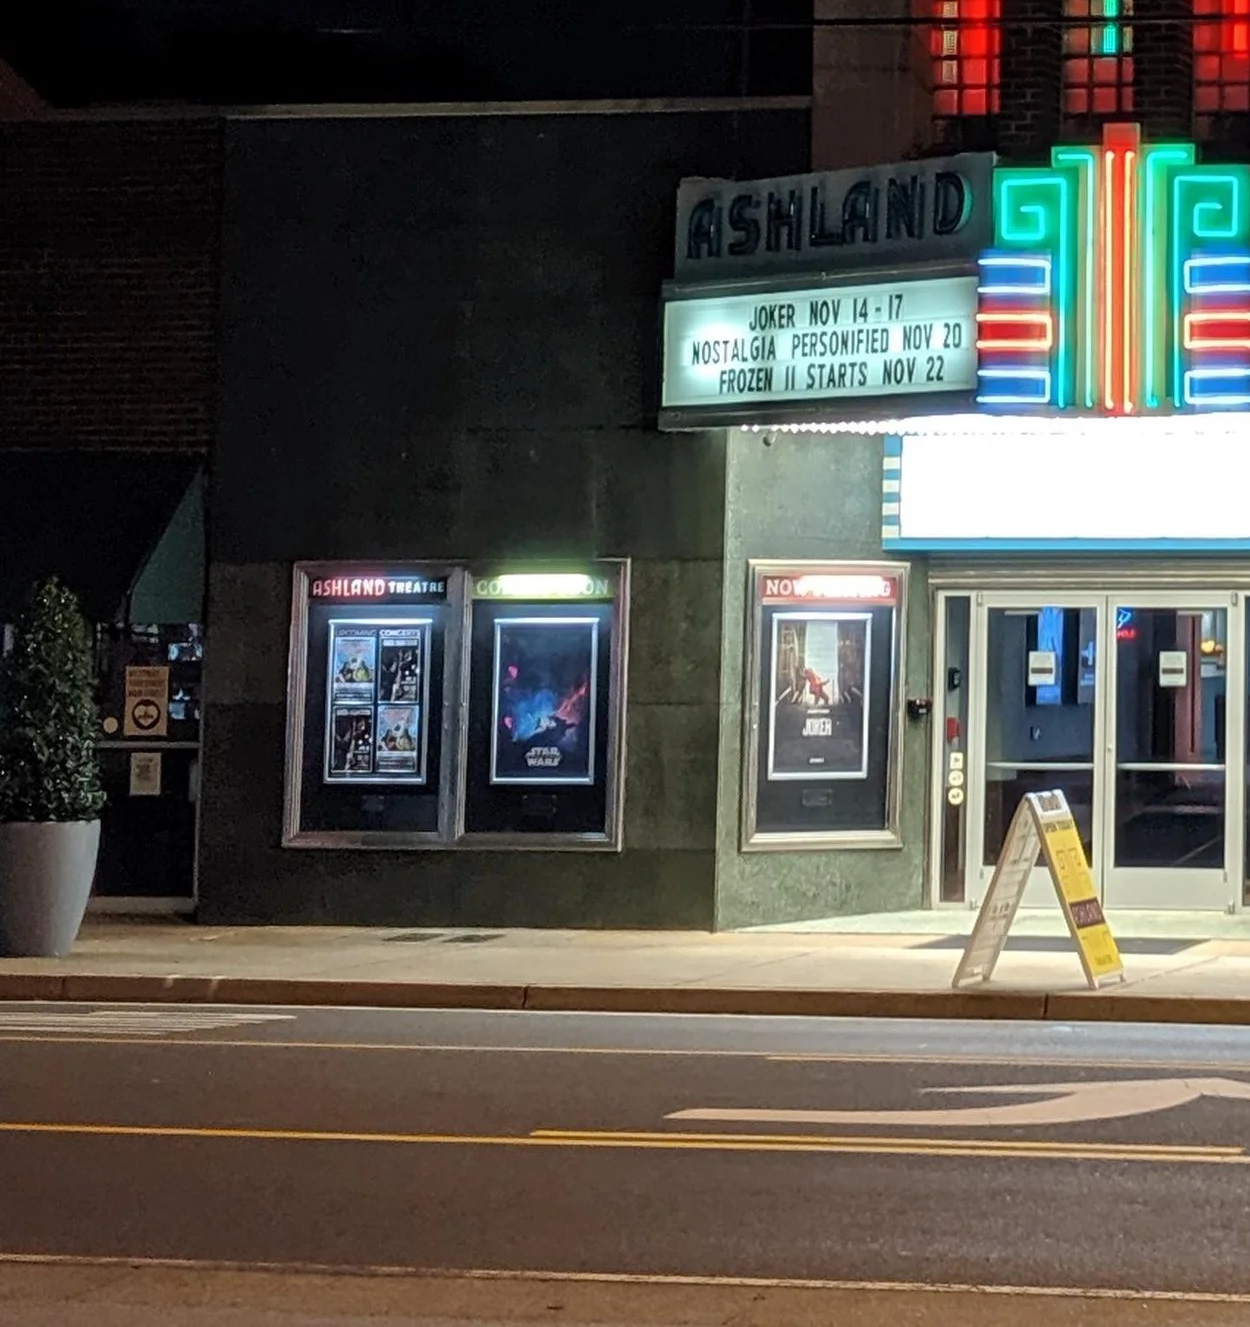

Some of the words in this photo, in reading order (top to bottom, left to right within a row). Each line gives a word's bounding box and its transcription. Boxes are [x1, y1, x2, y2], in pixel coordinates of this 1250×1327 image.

[686, 171, 970, 260] ASHLAND
[749, 304, 796, 332] JOKER
[808, 299, 841, 325] NOV
[852, 297, 869, 323] 14
[887, 294, 904, 320] 17
[692, 335, 778, 366] NOSTALGIA
[791, 326, 890, 359] PERSONIFIED
[902, 324, 934, 351] NOV
[943, 322, 962, 349] 20
[719, 368, 774, 394] FROZEN
[806, 362, 868, 390] STARTS
[882, 358, 916, 385] NOV
[925, 355, 945, 382] 22
[312, 577, 386, 597] ASHLAND
[388, 580, 445, 594] THEATRE
[525, 746, 561, 758] STAR
[525, 757, 562, 767] WARS
